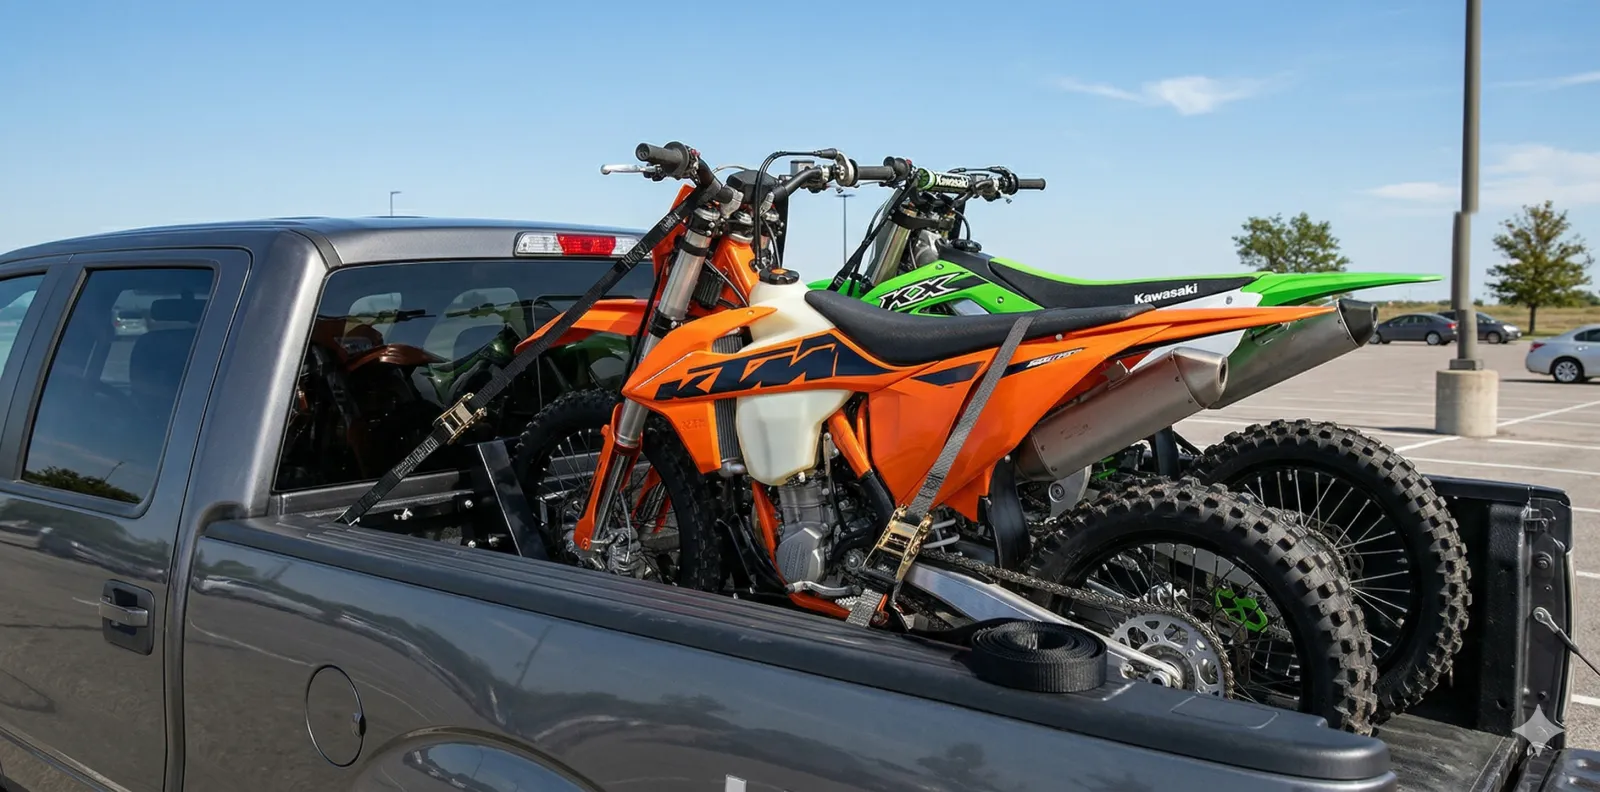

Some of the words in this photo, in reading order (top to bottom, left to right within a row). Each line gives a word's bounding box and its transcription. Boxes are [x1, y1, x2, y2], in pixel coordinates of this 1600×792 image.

[879, 272, 960, 311] KX
[1134, 283, 1198, 304] Kawasaki
[653, 333, 838, 401] KTM
